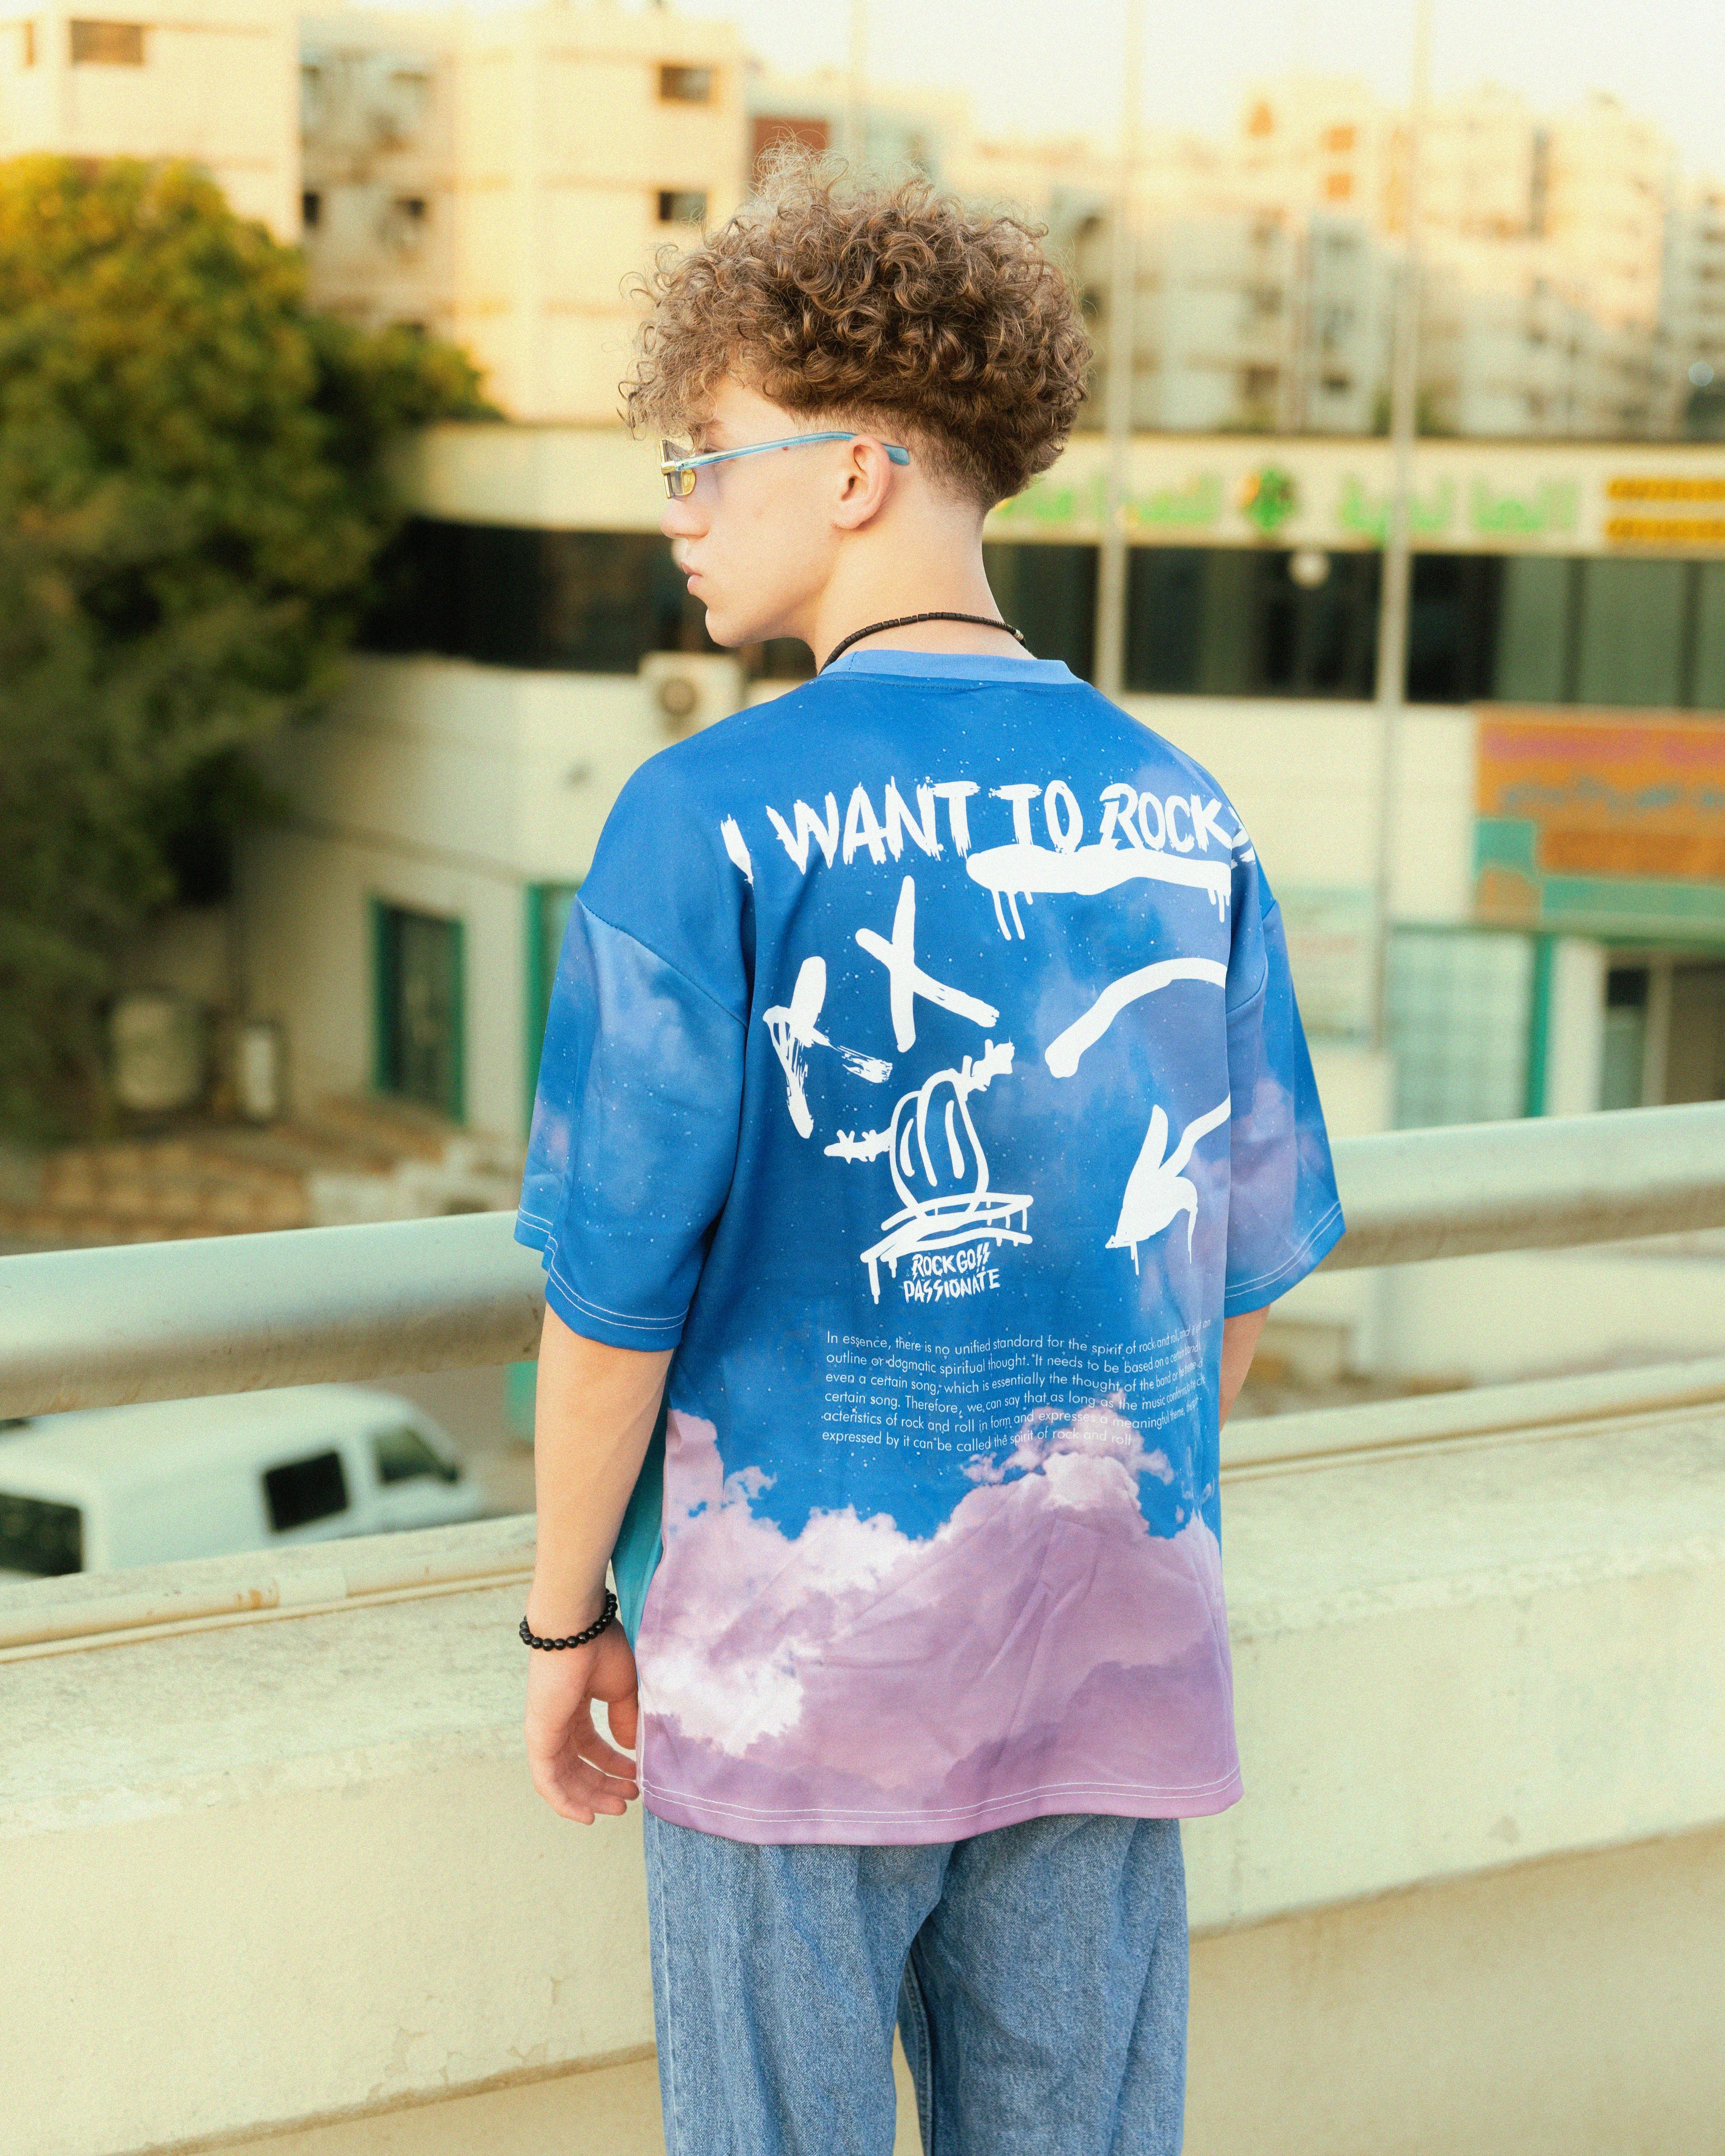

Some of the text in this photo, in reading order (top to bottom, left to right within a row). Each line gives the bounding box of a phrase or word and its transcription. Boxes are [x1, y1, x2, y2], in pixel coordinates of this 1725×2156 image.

[721, 814, 753, 889] I
[766, 775, 981, 874] WANT
[988, 780, 1083, 855] TO
[911, 1254, 957, 1282] ROCK
[903, 1269, 1000, 1303] PASSIONATE
[828, 1331, 837, 1344] In
[843, 1335, 891, 1350] essence,
[896, 1336, 921, 1351] there
[925, 1341, 932, 1353] is
[935, 1344, 950, 1355] no
[955, 1338, 990, 1355] unified
[993, 1335, 1043, 1350] standard
[1048, 1335, 1064, 1348] for
[1069, 1338, 1087, 1351] the
[1092, 1344, 1121, 1357] spirit
[1126, 1340, 1136, 1354] of
[1140, 1337, 1154, 1353] rock
[1157, 1332, 1169, 1348] and
[827, 1351, 867, 1365] outline
[872, 1357, 883, 1366] or
[888, 1354, 936, 1373] dogmatic
[940, 1355, 985, 1377] spiritual
[988, 1355, 1029, 1372] thought.
[1035, 1354, 1043, 1365] It
[1048, 1354, 1082, 1368] needs
[1087, 1360, 1099, 1371] to
[1104, 1360, 1119, 1373] be
[1125, 1356, 1153, 1373] based
[1155, 1358, 1164, 1368] on
[1165, 1357, 1169, 1365] a
[826, 1373, 854, 1383] even
[859, 1374, 866, 1385] a
[871, 1376, 907, 1388] certain
[912, 1382, 940, 1395] song,
[944, 1380, 979, 1394] which
[983, 1380, 989, 1391] is
[992, 1372, 1045, 1389] essentially
[1050, 1372, 1067, 1385] the
[1072, 1373, 1120, 1392] thought
[1125, 1379, 1136, 1392] of
[1140, 1377, 1154, 1391] the
[1156, 1370, 1170, 1387] band
[825, 1391, 865, 1404] certain
[871, 1397, 900, 1410] song.
[905, 1395, 962, 1416] Therefore,
[986, 1400, 1001, 1410] can
[1005, 1395, 1020, 1408] say
[1024, 1390, 1047, 1404] that
[1051, 1394, 1064, 1402] as
[1069, 1391, 1095, 1408] long
[1101, 1399, 1113, 1408] as
[1119, 1397, 1138, 1411] the
[1142, 1395, 1165, 1410] music
[823, 1410, 881, 1425] acteristics
[886, 1413, 897, 1426] of
[901, 1416, 924, 1429] rock
[928, 1418, 949, 1432] and
[954, 1419, 974, 1432] roll
[979, 1420, 987, 1430] in
[991, 1415, 1010, 1428] form
[1014, 1409, 1033, 1423] and
[1039, 1410, 1100, 1425] expresses
[1113, 1410, 1170, 1430] meaningful
[822, 1426, 1130, 1452] expressed by it can be called the spirit of rock and roll
